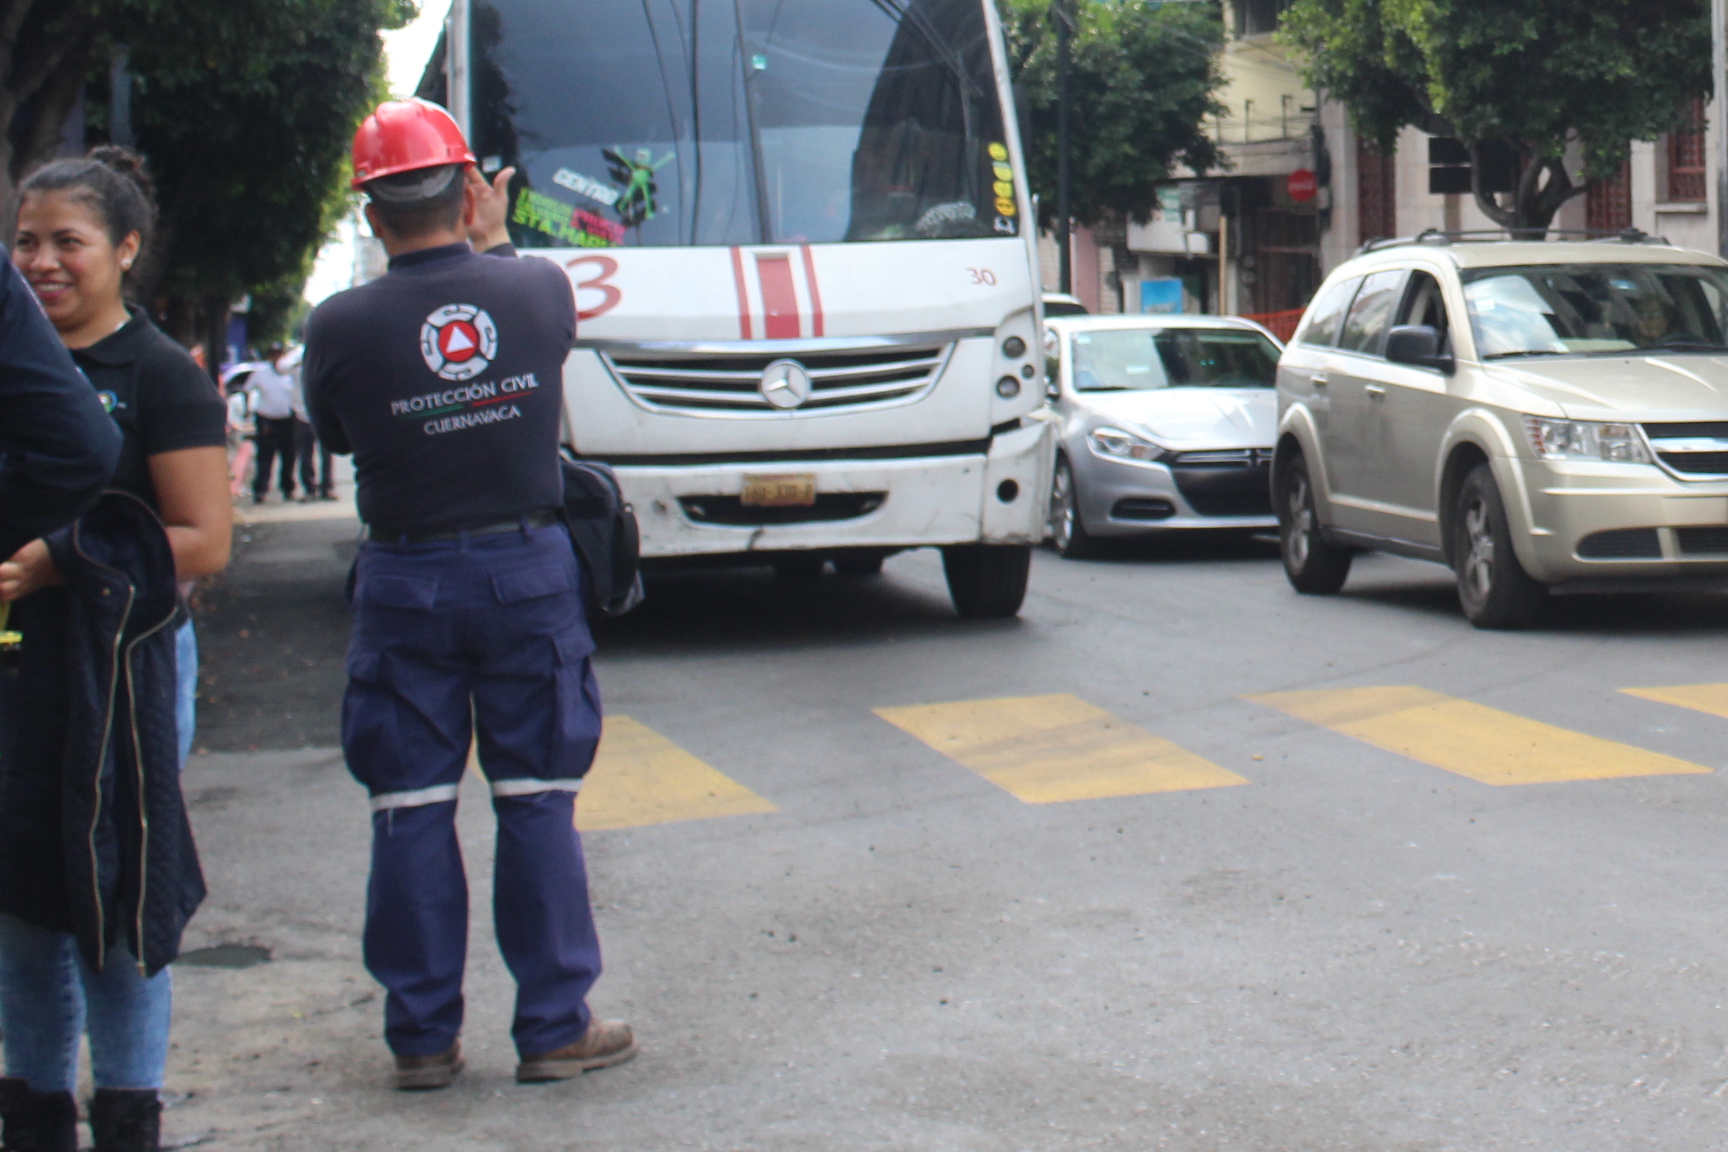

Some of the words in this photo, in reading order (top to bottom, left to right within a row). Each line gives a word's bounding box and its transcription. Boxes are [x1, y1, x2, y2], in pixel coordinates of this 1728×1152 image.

[966, 267, 997, 286] 30
[390, 382, 497, 416] PROTECCIÓN
[501, 372, 540, 393] CIVIL
[423, 405, 522, 435] CUERNAVACA
